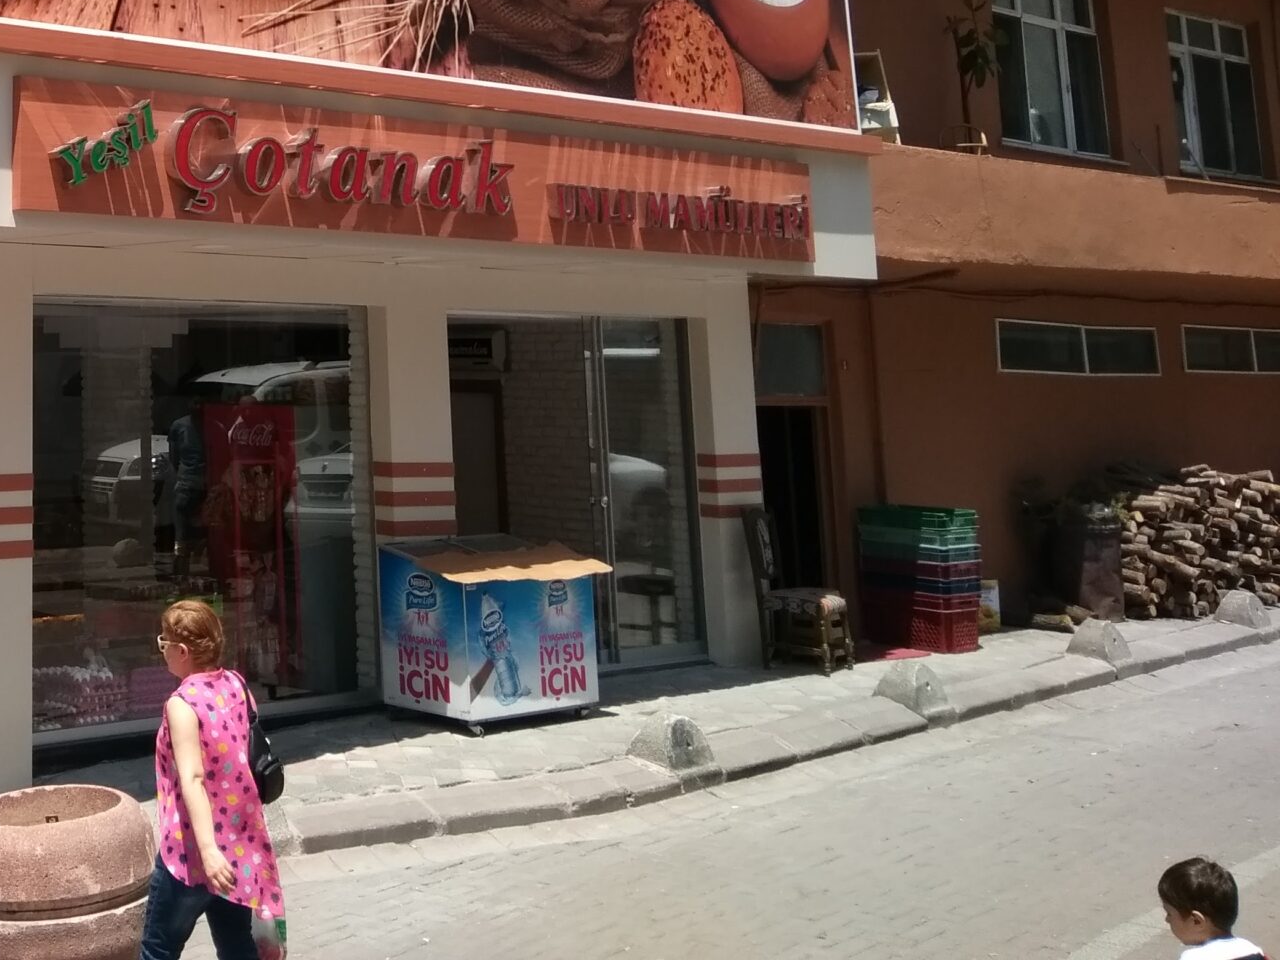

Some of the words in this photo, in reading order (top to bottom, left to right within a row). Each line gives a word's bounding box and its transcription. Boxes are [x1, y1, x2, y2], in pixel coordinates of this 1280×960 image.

[53, 100, 159, 187] Yeşil
[168, 106, 516, 216] Çotanak
[398, 642, 420, 667] İYİ
[424, 648, 449, 672] SU
[540, 643, 560, 666] İYİ
[563, 642, 584, 663] SU
[399, 664, 450, 704] İÇİN
[541, 664, 587, 701] İÇİN
